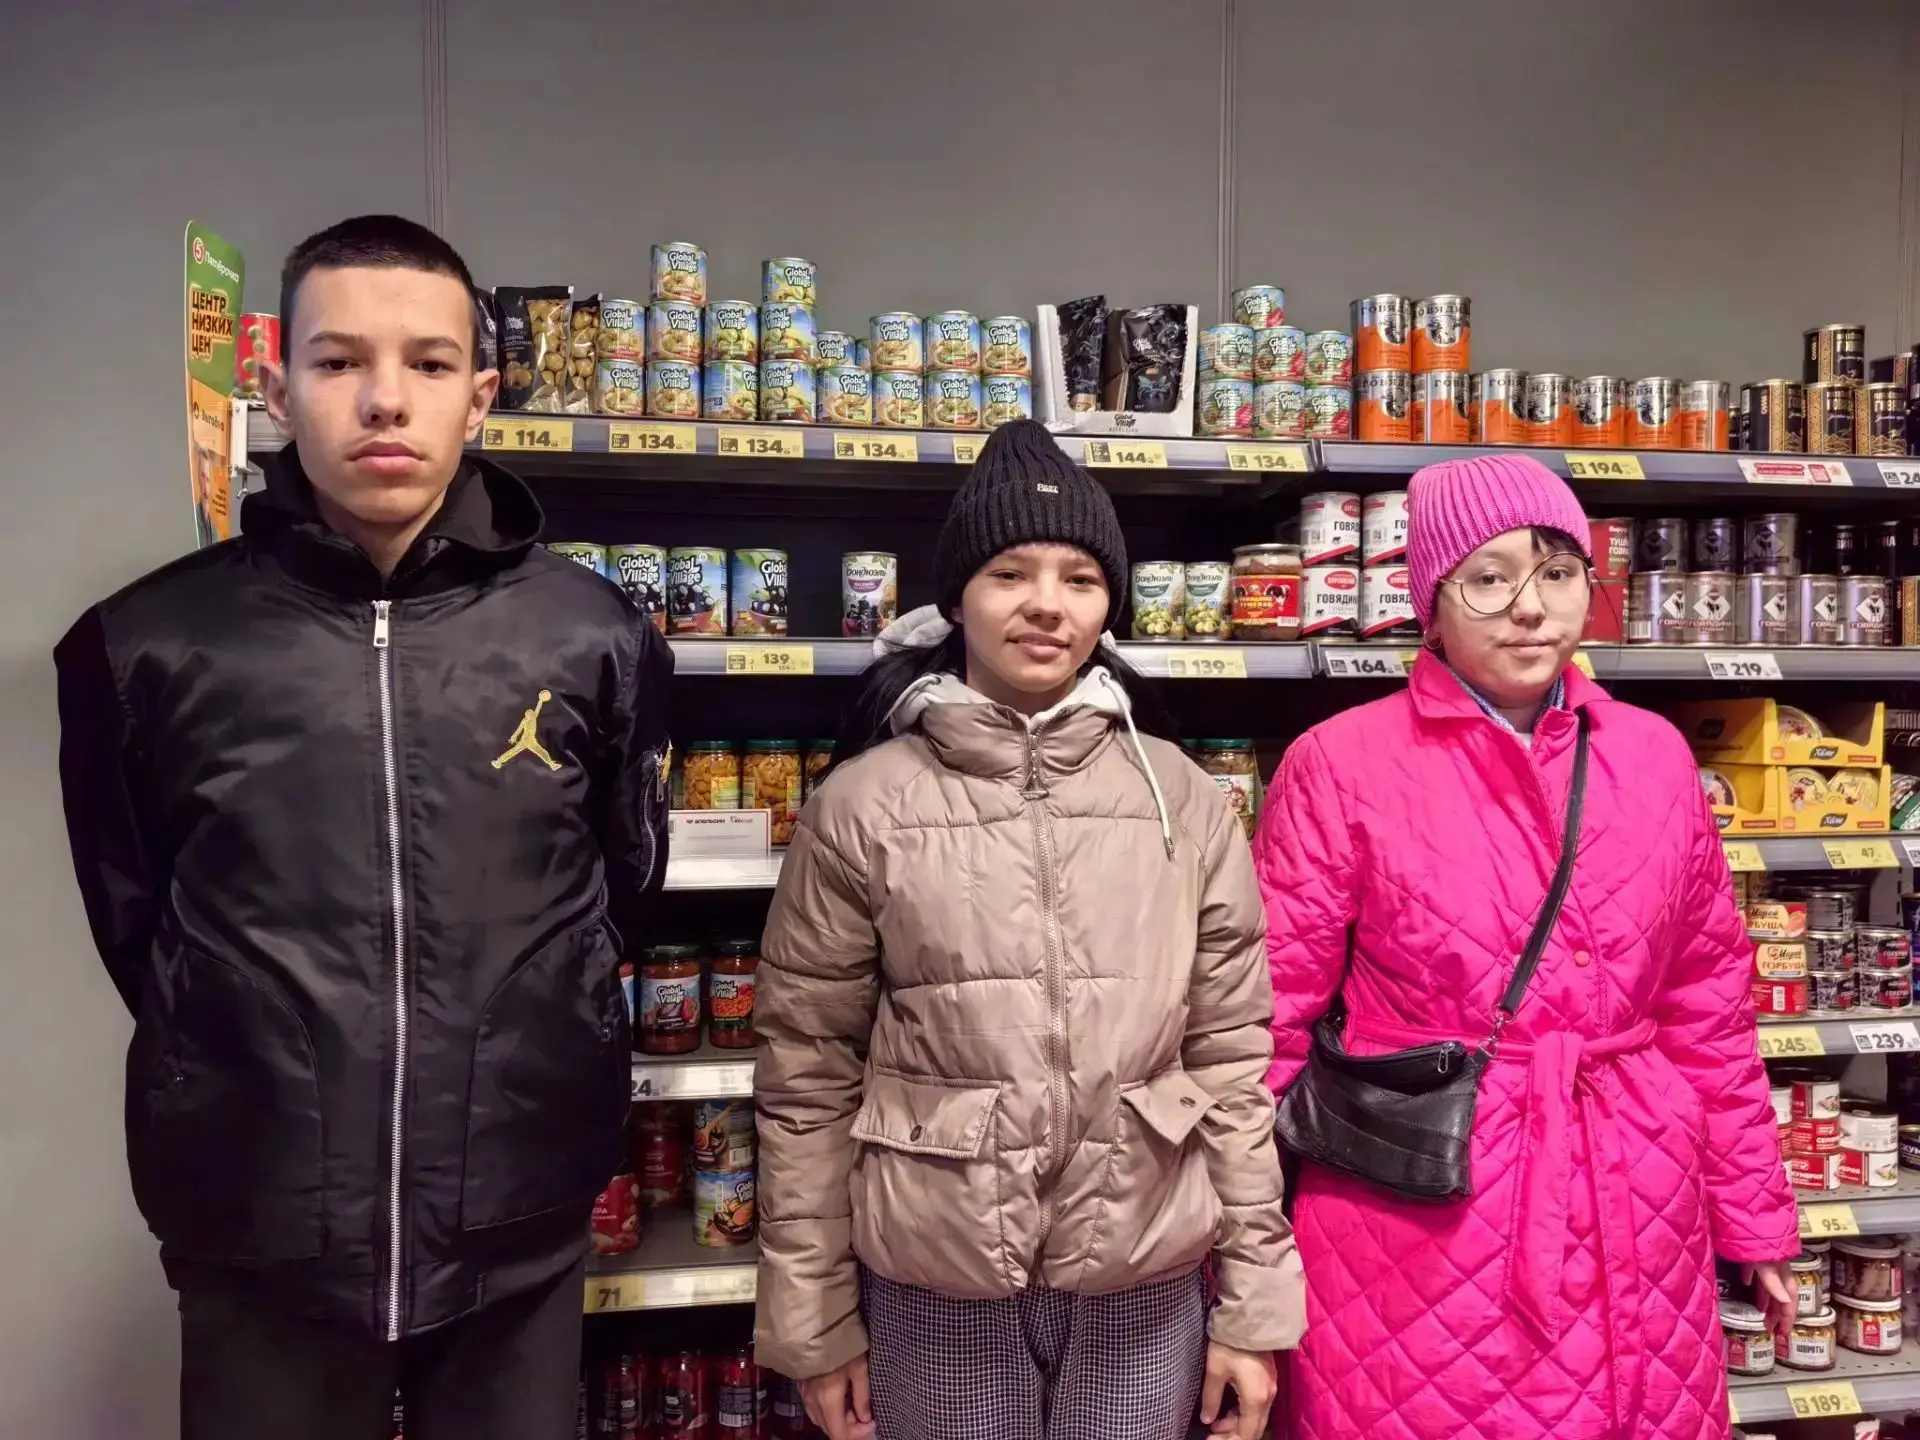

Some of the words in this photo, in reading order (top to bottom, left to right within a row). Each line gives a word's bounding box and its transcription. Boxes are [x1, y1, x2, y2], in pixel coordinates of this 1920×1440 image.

[669, 251, 695, 264] Global
[672, 261, 698, 272] Village
[785, 267, 809, 278] Global
[787, 275, 811, 287] Village
[192, 290, 226, 313] ЦЕНТР
[604, 310, 630, 321] Global
[669, 311, 695, 322] Global
[718, 310, 744, 321] Global
[765, 311, 789, 321] Global
[192, 312, 232, 337] НИЗКИХ
[606, 317, 633, 329] Village
[672, 319, 697, 331] Village
[720, 317, 747, 329] Village
[766, 317, 791, 329] Village
[881, 321, 907, 332] Global
[941, 321, 967, 332] Global
[882, 330, 908, 341] Village
[943, 329, 969, 340] Village
[989, 326, 1016, 338] Global
[192, 333, 211, 355] ЦЕН
[991, 335, 1017, 346] Village
[819, 342, 843, 353] Global
[820, 349, 845, 359] Village
[611, 369, 638, 381] Global
[660, 369, 687, 380] Global
[766, 369, 791, 380] Global
[840, 375, 866, 386] Global
[614, 377, 640, 389] Village
[663, 377, 690, 389] Village
[767, 377, 793, 389] Village
[892, 380, 918, 391] Global
[942, 379, 968, 390] Global
[842, 384, 867, 396] Village
[895, 388, 919, 400] Village
[943, 387, 969, 399] Village
[989, 384, 1016, 395] Global
[991, 392, 1017, 404] Village
[515, 430, 551, 446] 114
[638, 434, 675, 449] 134
[746, 438, 783, 453] 134
[861, 443, 898, 457] 134
[1116, 451, 1146, 463] 144
[1254, 455, 1287, 468] 134
[1588, 461, 1624, 474] 194
[619, 556, 657, 570] Global
[622, 569, 658, 583] Village
[763, 653, 790, 664] 139
[1192, 660, 1225, 673] 139
[1351, 660, 1386, 673] 164
[1731, 663, 1762, 676] 219
[1861, 848, 1875, 858] 47
[657, 985, 683, 996] Global
[716, 982, 737, 991] Global
[661, 993, 685, 1003] Village
[717, 989, 738, 998] Village
[1773, 1037, 1807, 1053] 245
[1872, 1033, 1905, 1049] 239
[1822, 1219, 1841, 1231] 95
[599, 1287, 622, 1307] 71
[1810, 1395, 1842, 1413] 189
